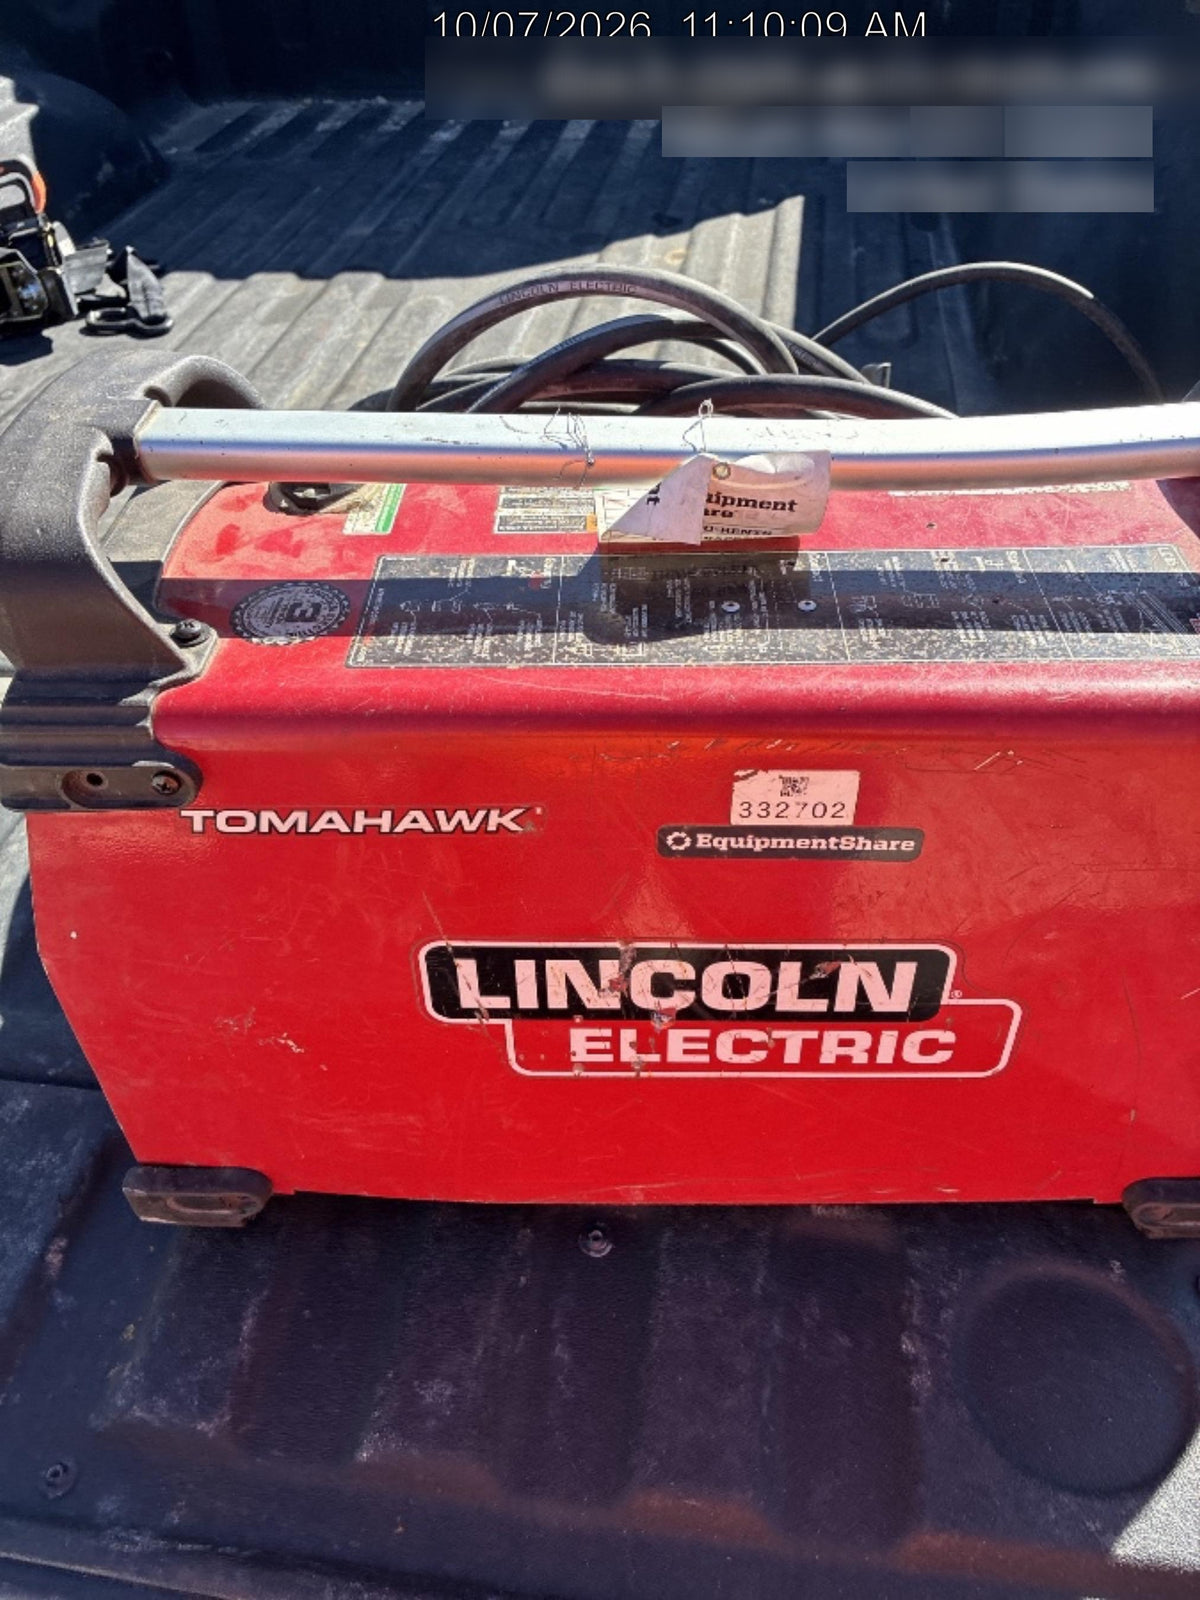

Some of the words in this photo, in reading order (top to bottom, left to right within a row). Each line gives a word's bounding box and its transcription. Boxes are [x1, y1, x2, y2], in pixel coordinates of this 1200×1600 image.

[180, 808, 528, 834] TOMAHAWK
[738, 801, 846, 819] 332702
[695, 833, 915, 852] EquipmentShare
[453, 957, 918, 1012] LINCOLN
[569, 1027, 957, 1065] ELECTRIC
